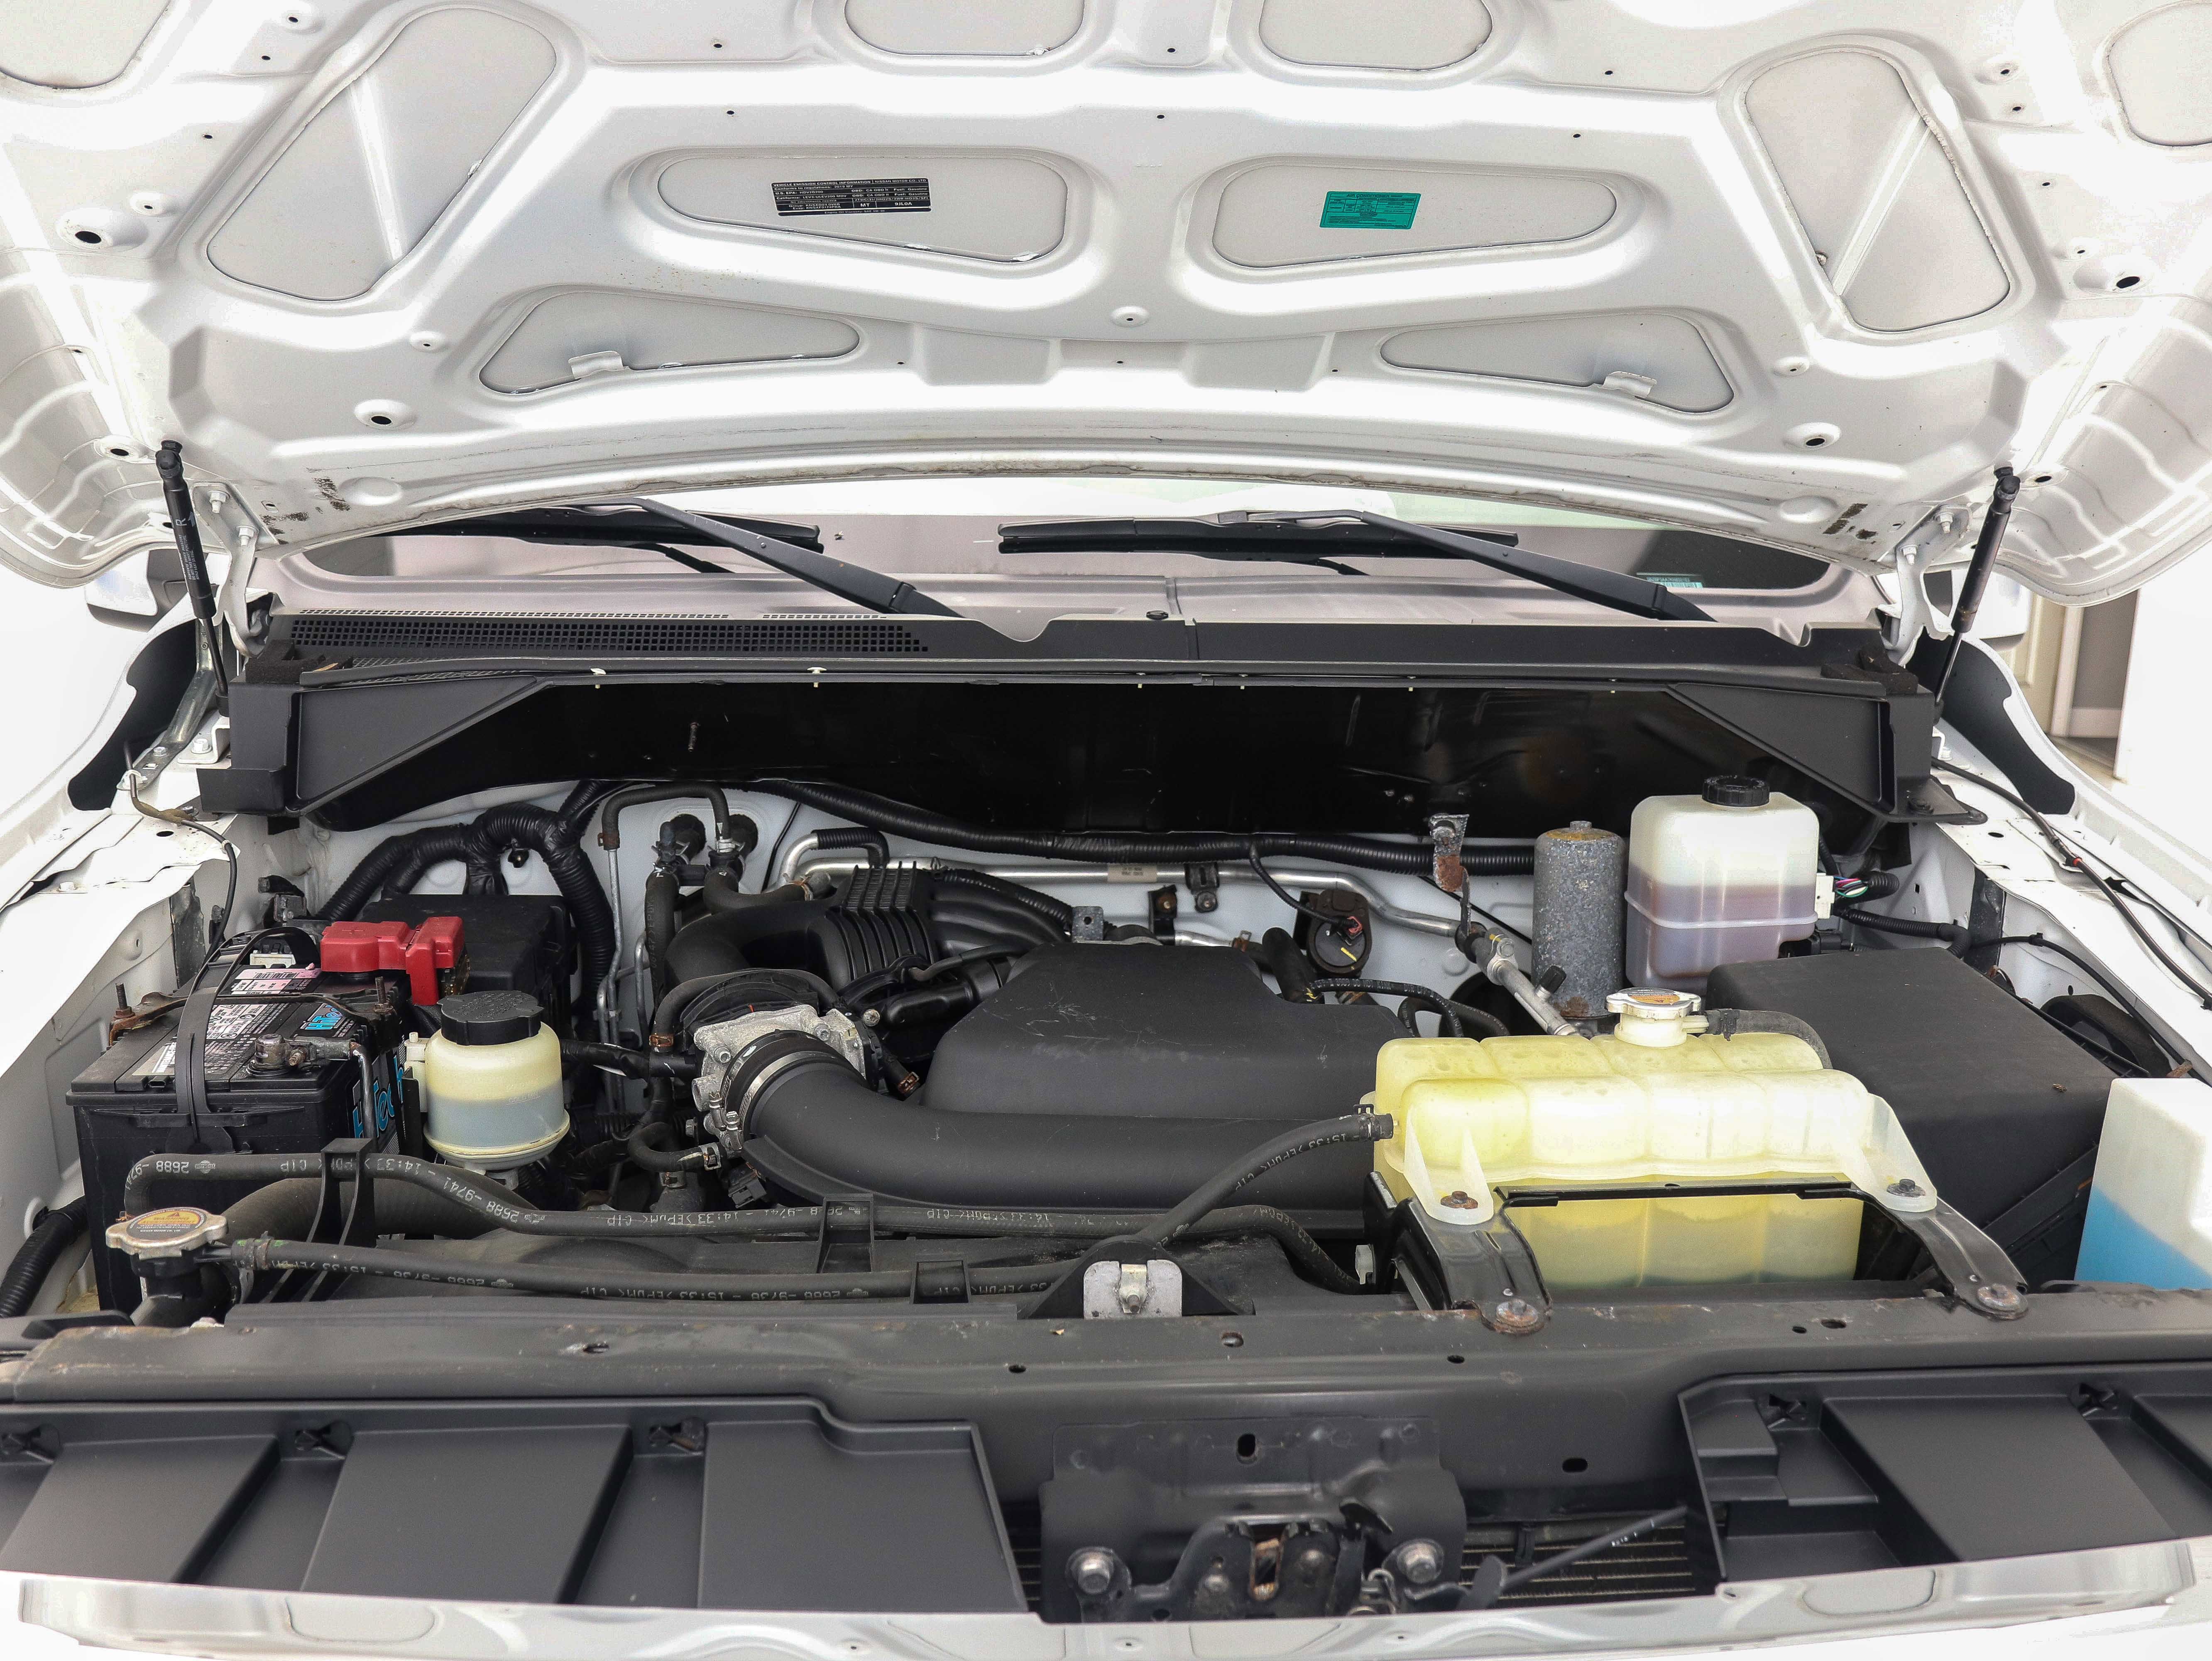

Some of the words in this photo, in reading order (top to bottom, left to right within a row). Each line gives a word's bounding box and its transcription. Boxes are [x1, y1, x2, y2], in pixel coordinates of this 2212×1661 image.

[175, 517, 187, 526] R
[305, 1004, 343, 1031] HiTe
[156, 1160, 190, 1174] 2688
[279, 1158, 308, 1172] CIP
[376, 1157, 422, 1176] 14:33
[486, 1201, 519, 1223] 2688
[697, 1212, 738, 1224] 14:33
[810, 1207, 843, 1216] 268
[926, 1209, 950, 1218] CIP
[607, 1215, 632, 1227] CIP
